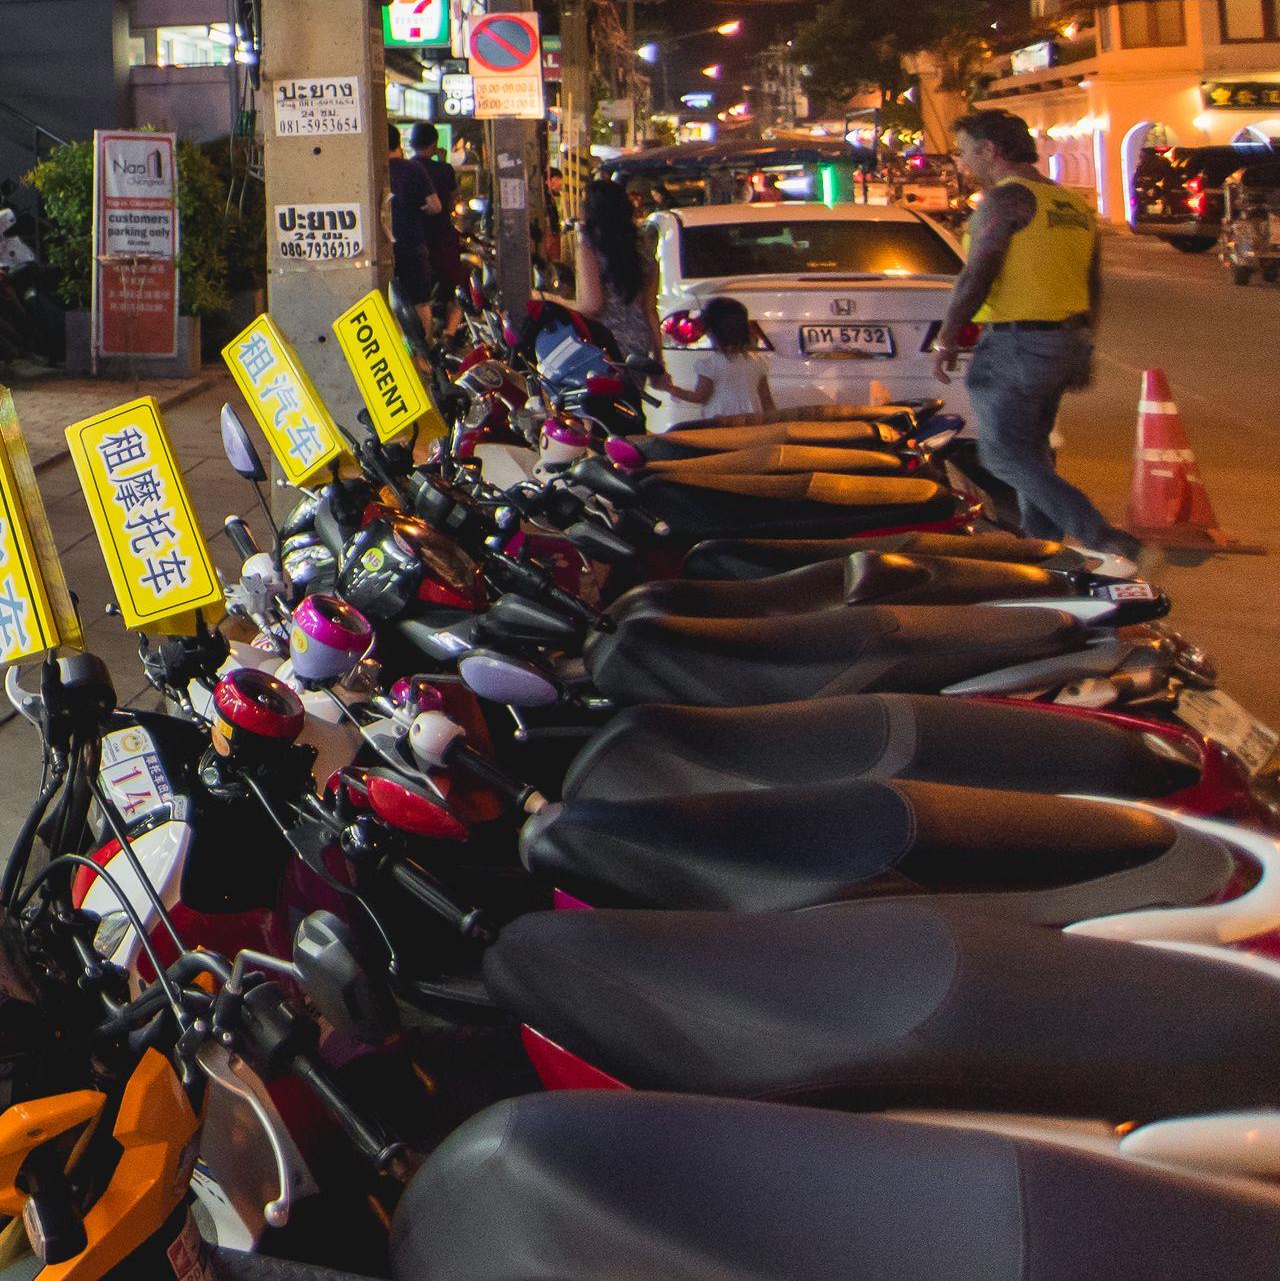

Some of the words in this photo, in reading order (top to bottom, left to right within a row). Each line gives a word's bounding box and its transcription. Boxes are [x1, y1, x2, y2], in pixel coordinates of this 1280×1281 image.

[279, 82, 353, 100] ปะยาง
[301, 110, 315, 118] 24
[280, 117, 359, 134] 081-5953654
[112, 159, 145, 176] Nap
[108, 213, 169, 225] customers
[278, 207, 357, 232] ปะยาง
[107, 227, 147, 239] parking
[149, 227, 170, 240] only
[294, 232, 316, 240] 24
[840, 328, 886, 343] 5732
[349, 311, 380, 359] FOR
[370, 357, 409, 419] RENT
[235, 330, 325, 469] 租汽车
[98, 425, 192, 599] 租摩托车
[111, 766, 152, 815] 14
